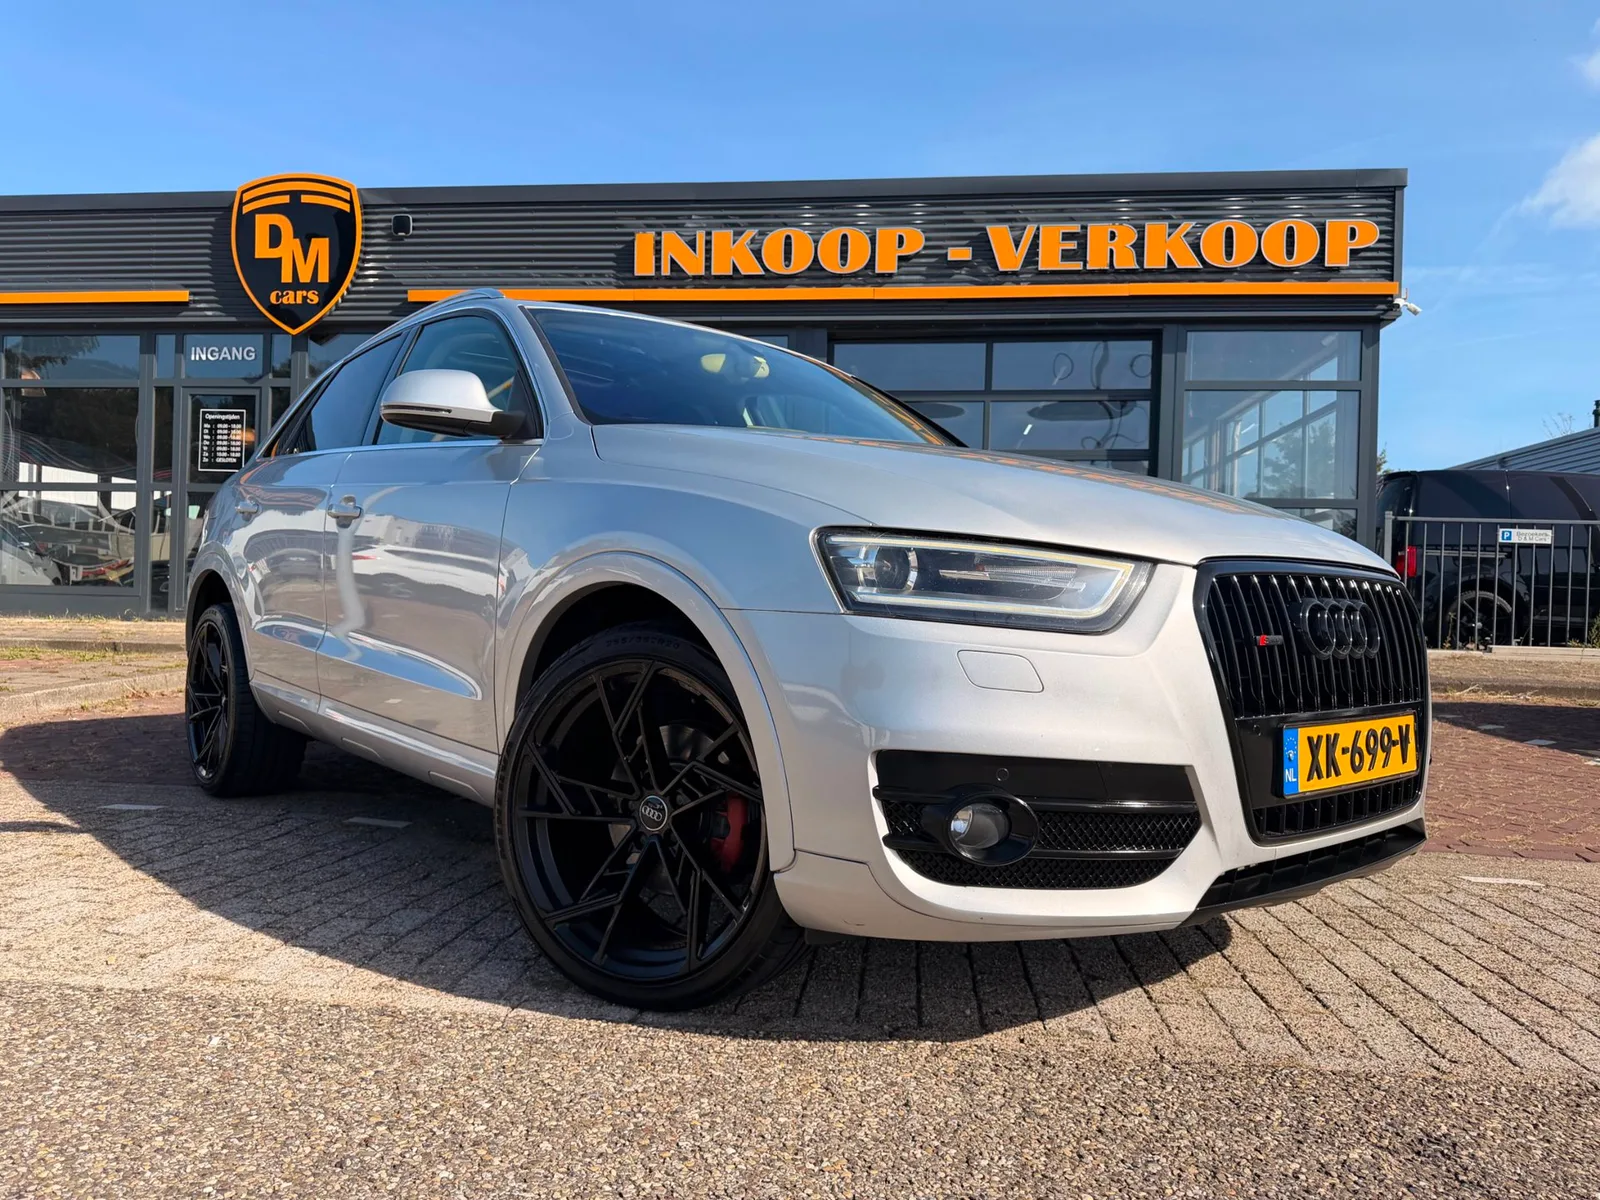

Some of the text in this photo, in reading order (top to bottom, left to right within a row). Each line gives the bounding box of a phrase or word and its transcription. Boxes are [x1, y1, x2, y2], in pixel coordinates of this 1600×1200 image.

[255, 213, 330, 283] DM
[634, 227, 926, 276] INKOOP
[986, 219, 1380, 272] VERKOOP
[269, 289, 320, 305] cars
[190, 346, 256, 361] INGANG
[1306, 724, 1411, 782] XK-699-V
[1285, 768, 1297, 782] NL
